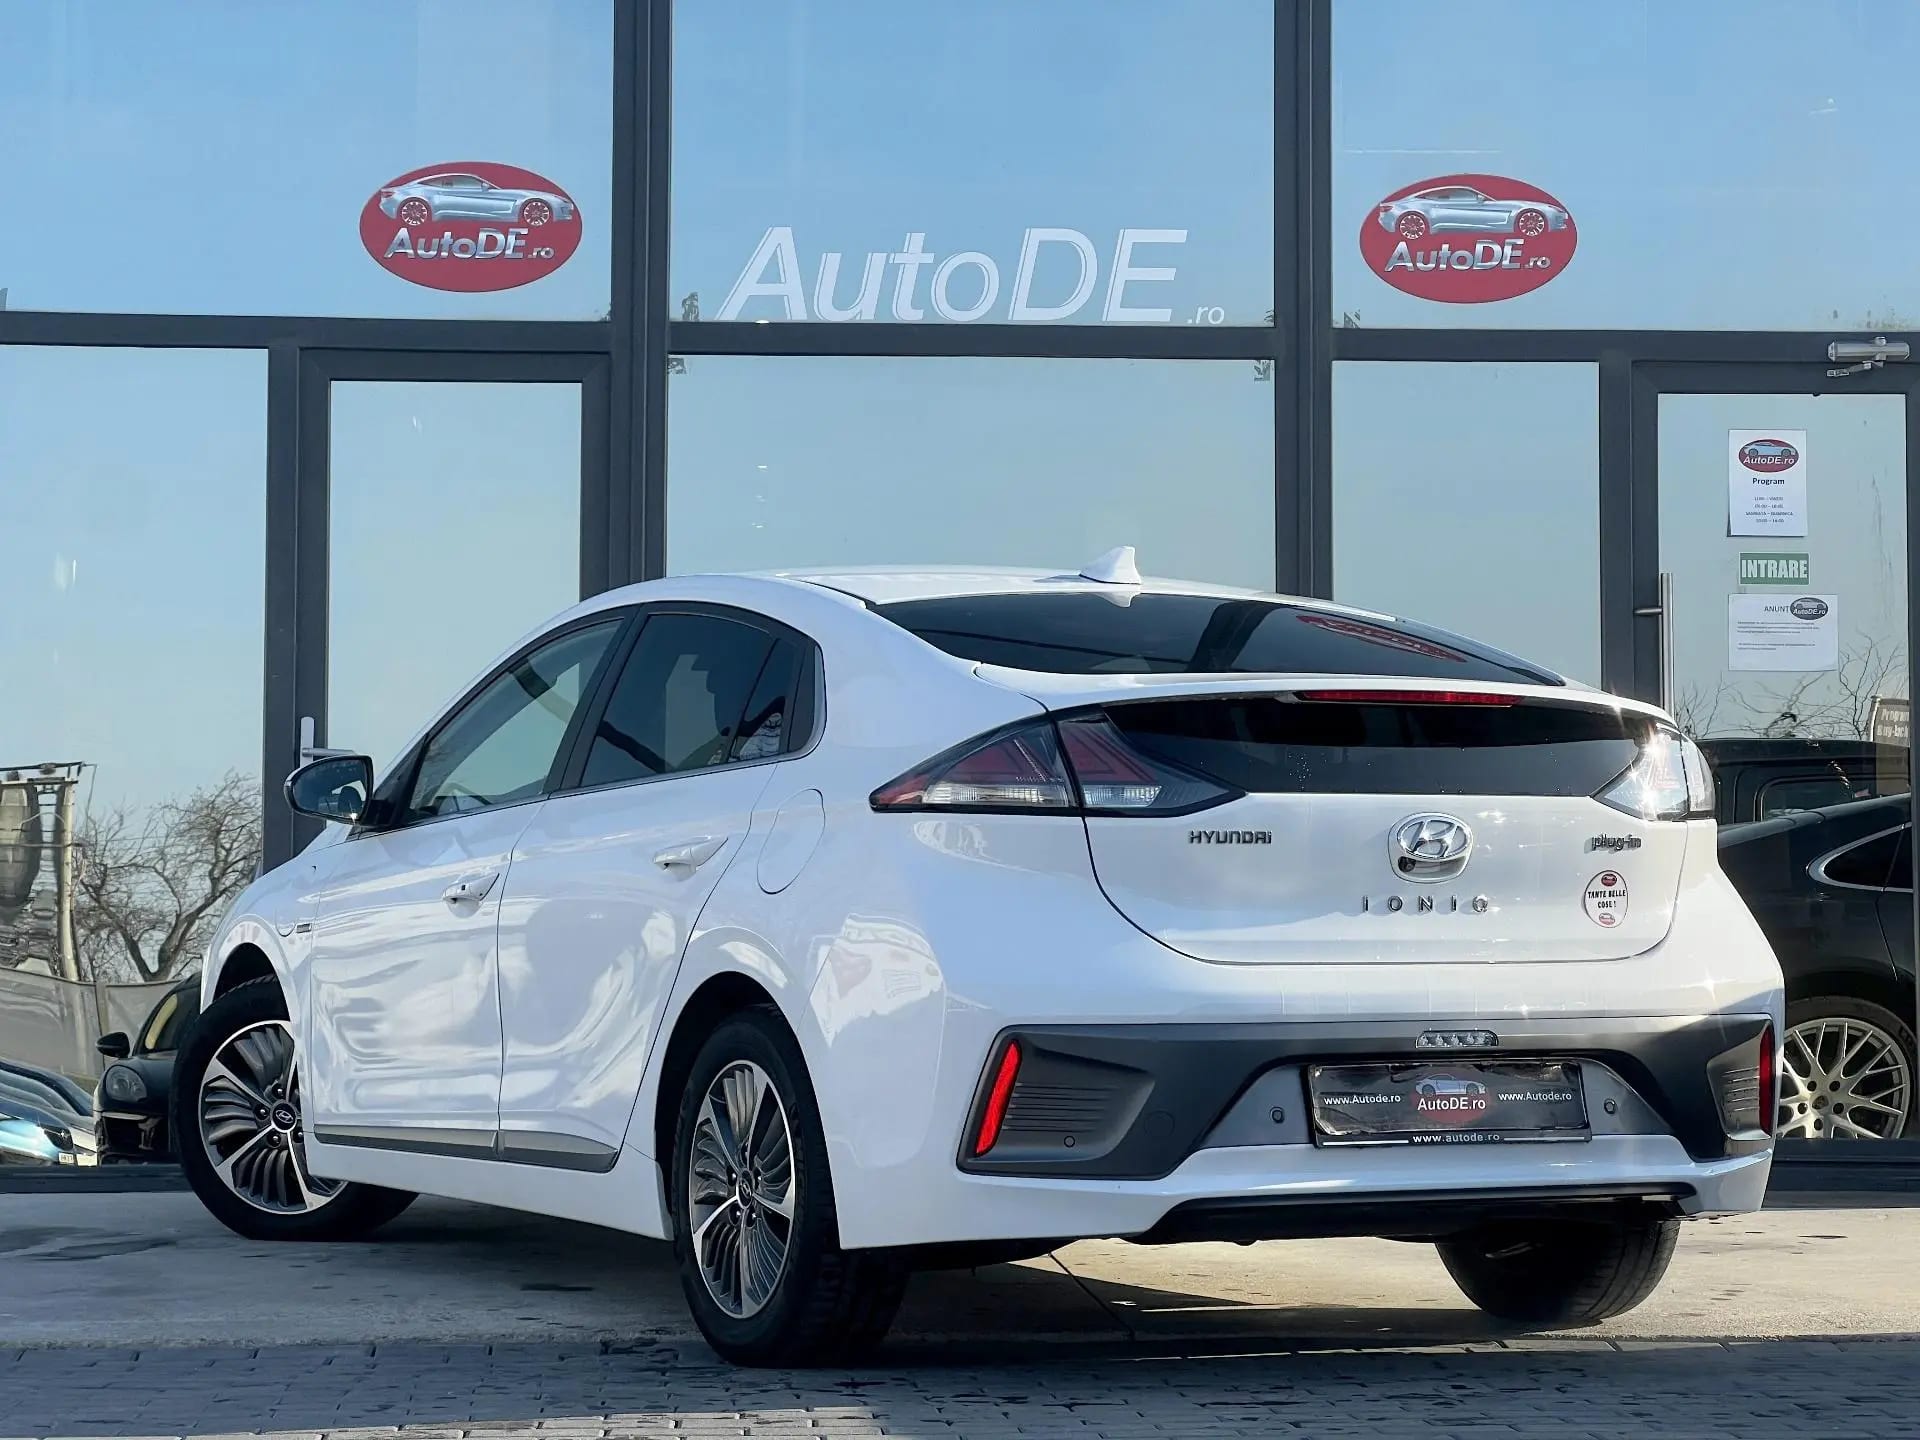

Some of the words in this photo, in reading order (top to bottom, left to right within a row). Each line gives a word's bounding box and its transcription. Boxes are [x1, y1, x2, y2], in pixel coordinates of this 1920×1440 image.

[1743, 456, 1795, 465] AutoDE.ro
[1752, 477, 1785, 486] Program
[1741, 559, 1808, 579] INTRARE
[1188, 829, 1273, 845] HYUNDAI
[1591, 833, 1642, 851] plug-in
[1588, 890, 1607, 899] TANTE
[1608, 889, 1626, 898] BELLE
[1362, 894, 1489, 914] IONIQ
[1597, 901, 1612, 909] COSE
[1323, 1093, 1402, 1106] www.Autode.ro
[1417, 1096, 1487, 1111] AutoDE.ro
[1497, 1090, 1573, 1102] www.Autode.ro
[1412, 1132, 1501, 1144] www.autode.ro
